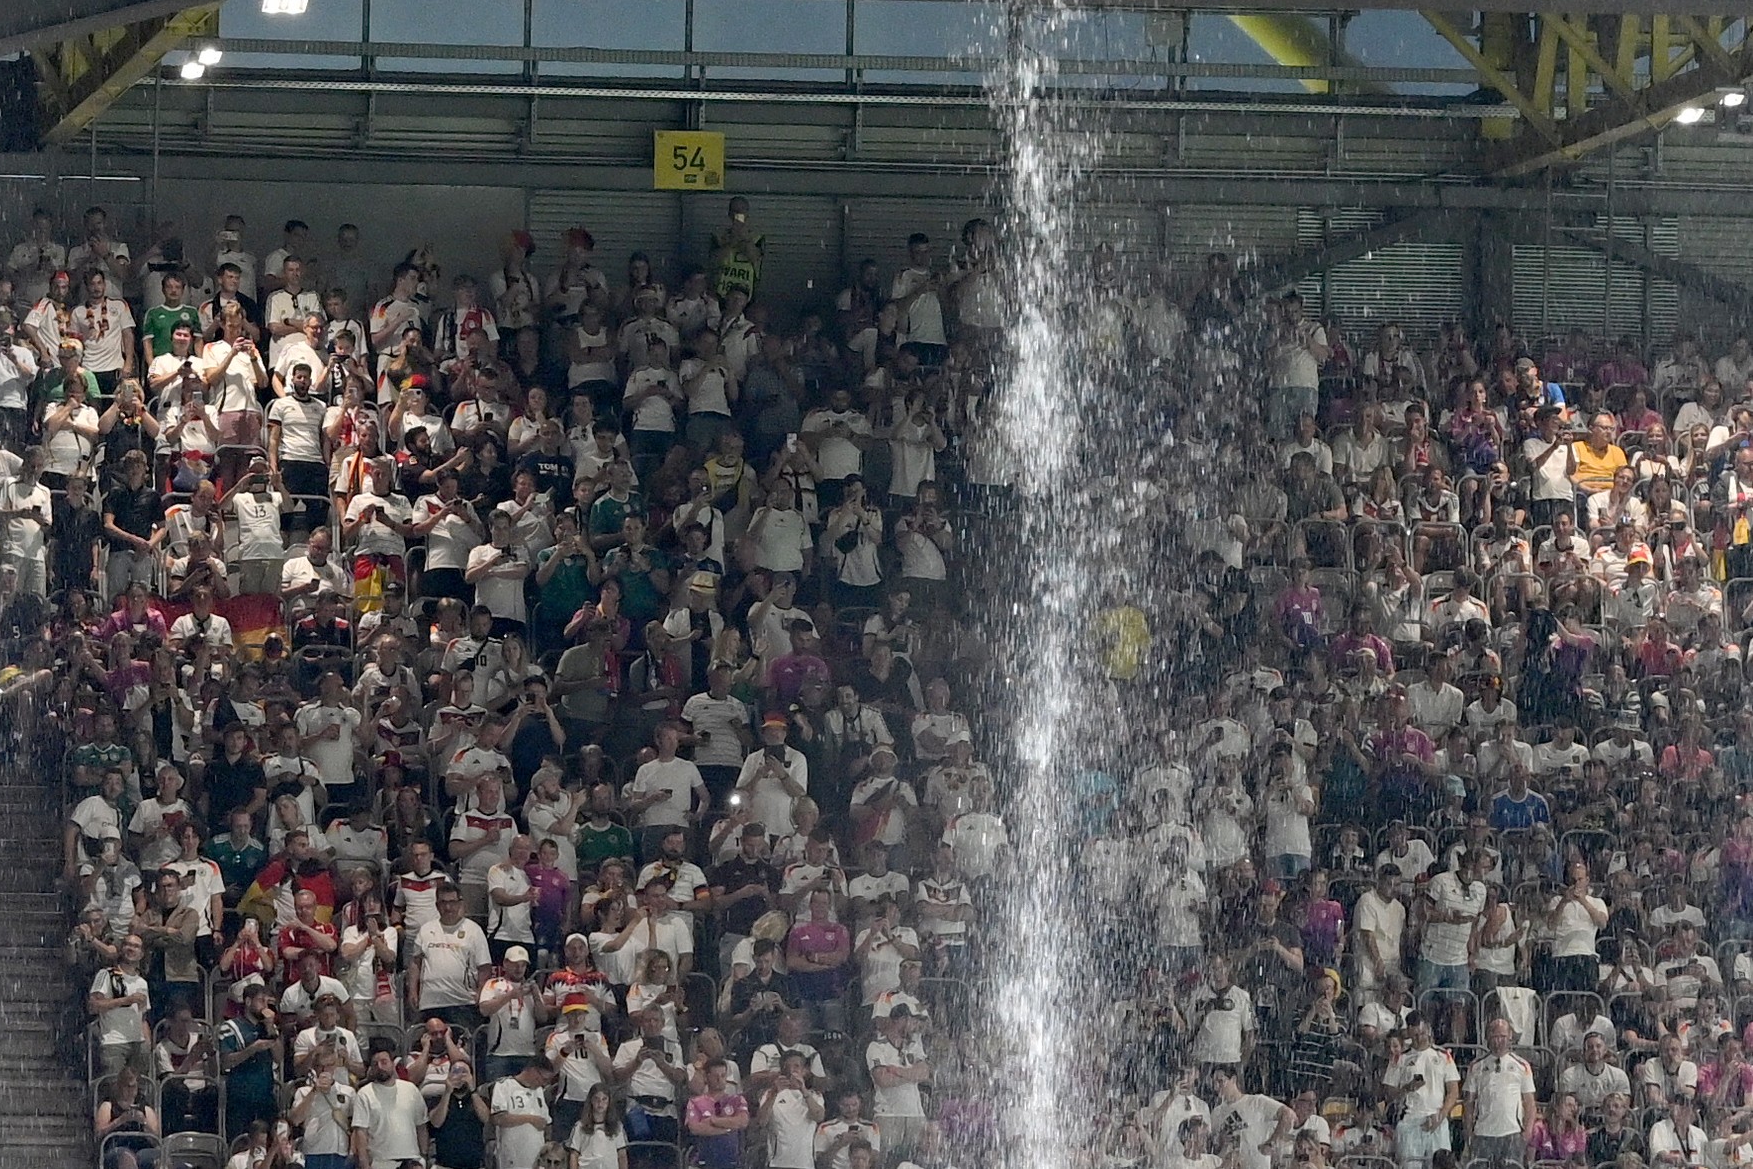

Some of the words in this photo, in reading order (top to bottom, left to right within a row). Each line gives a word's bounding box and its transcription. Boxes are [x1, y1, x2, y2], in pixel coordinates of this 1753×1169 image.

[673, 145, 705, 171] 54
[253, 505, 266, 517] 13
[476, 656, 487, 667] 10
[510, 1096, 524, 1109] 13
